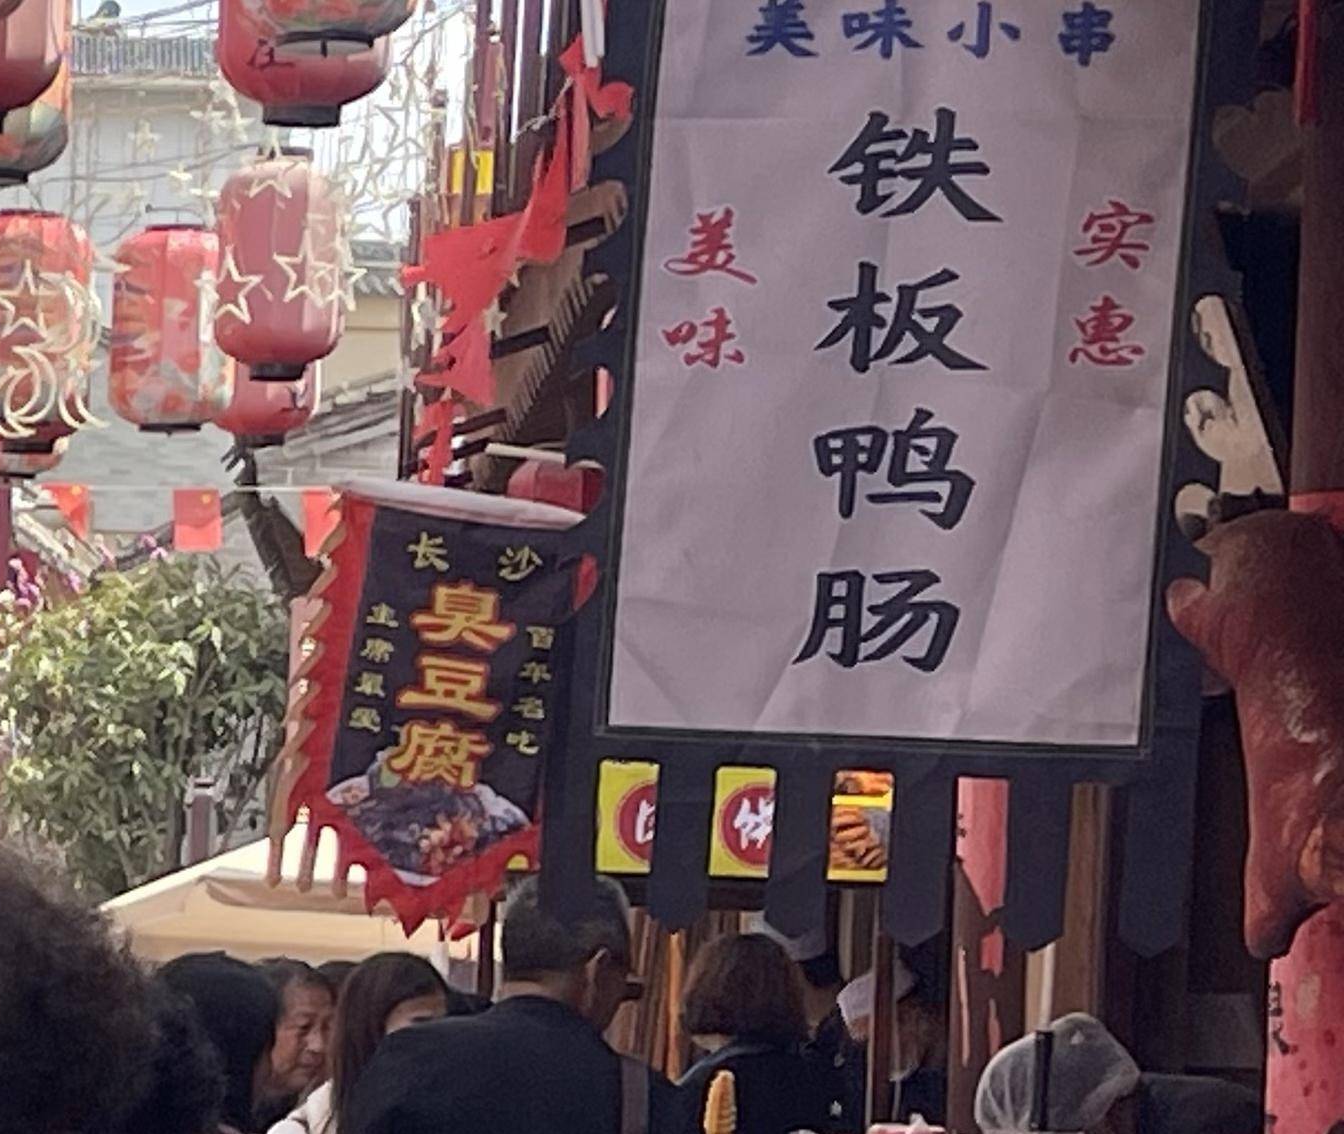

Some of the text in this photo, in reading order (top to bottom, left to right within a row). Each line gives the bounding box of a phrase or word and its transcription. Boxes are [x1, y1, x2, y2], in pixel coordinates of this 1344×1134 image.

[746, 0, 1118, 67] 美味小串
[662, 207, 758, 369] 美味
[1069, 201, 1156, 368] 实惠
[792, 107, 1004, 673] 铁板鸭肠
[407, 531, 543, 582] 长沙
[394, 584, 518, 789] 臭豆腐
